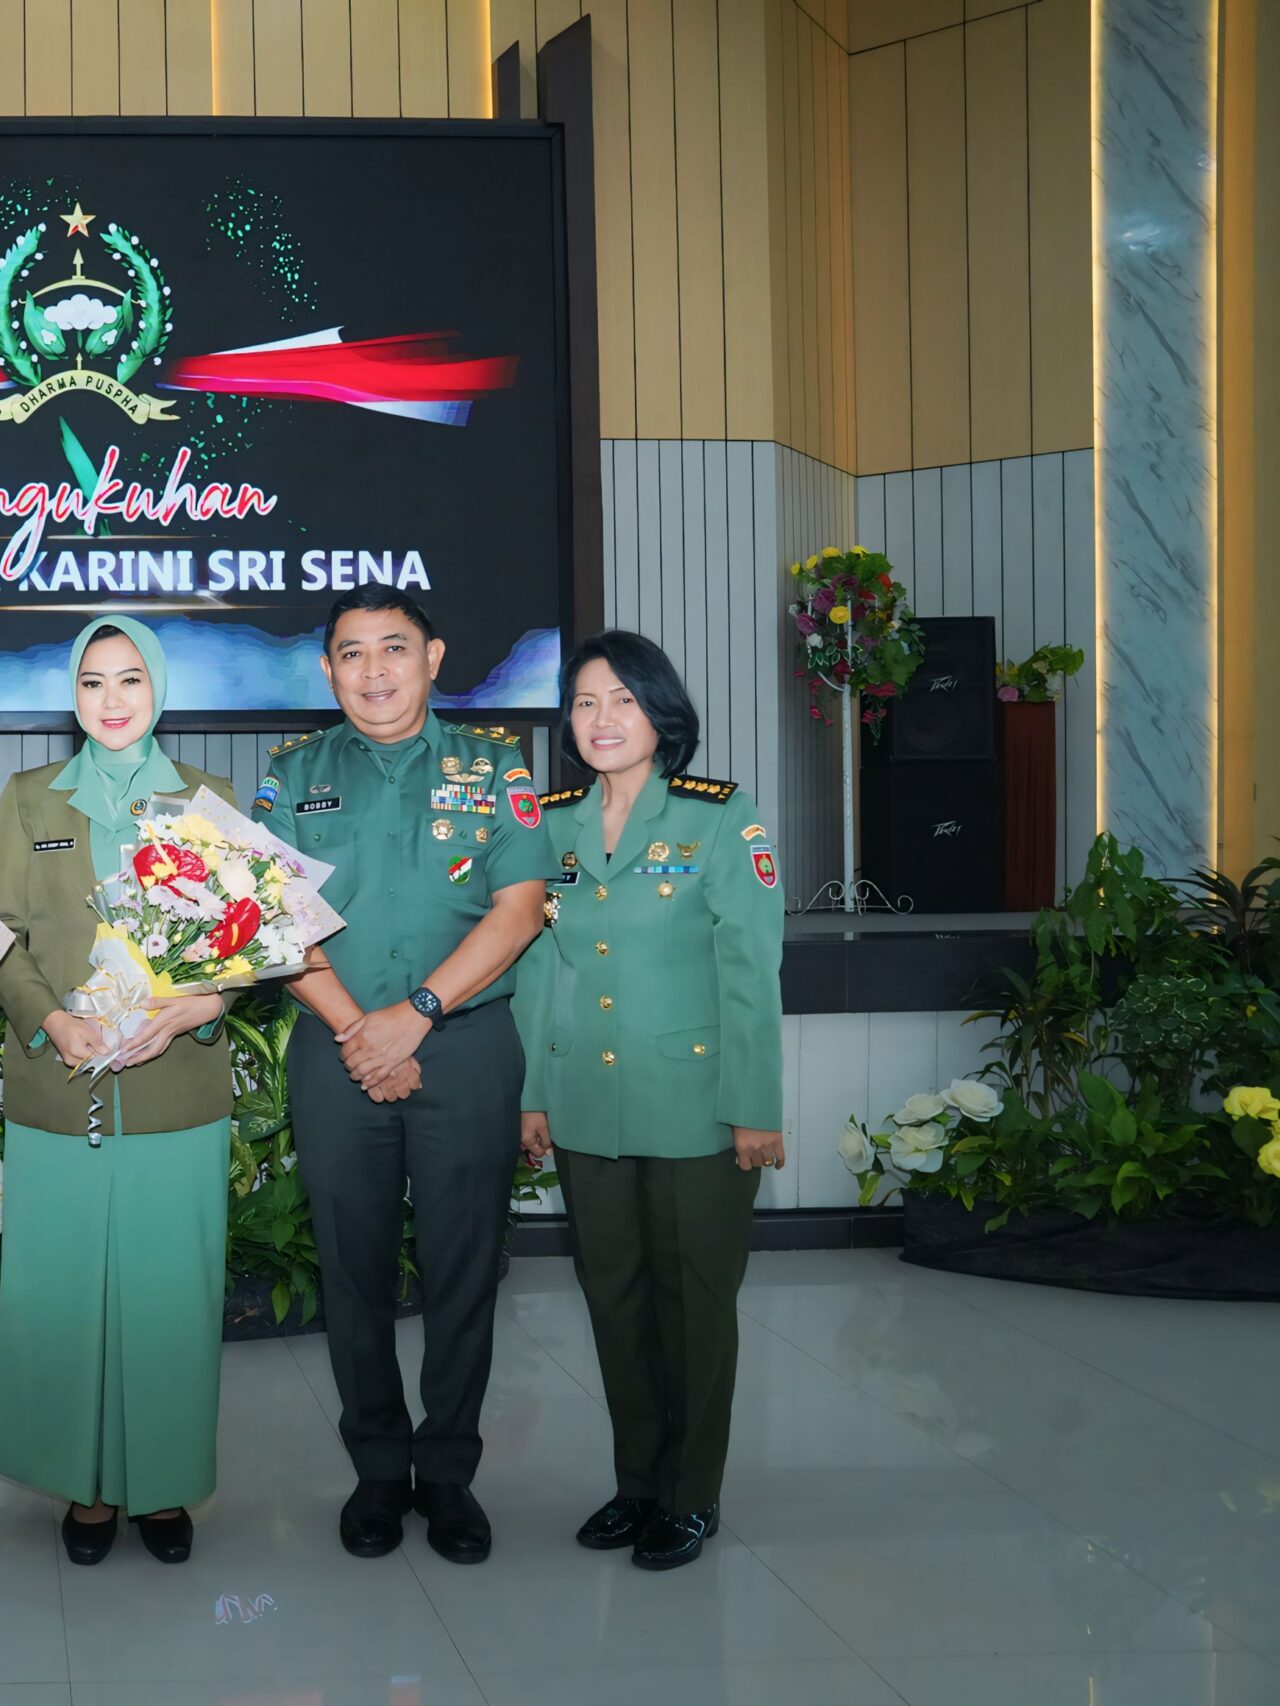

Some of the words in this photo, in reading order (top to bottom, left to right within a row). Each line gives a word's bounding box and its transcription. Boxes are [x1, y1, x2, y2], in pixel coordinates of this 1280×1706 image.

[19, 374, 77, 414] DHARMA
[85, 374, 139, 416] PUSPHA
[17, 550, 194, 592] KARINI
[208, 549, 286, 592] SRI
[300, 549, 432, 592] SENA
[303, 801, 332, 811] BOBBY
